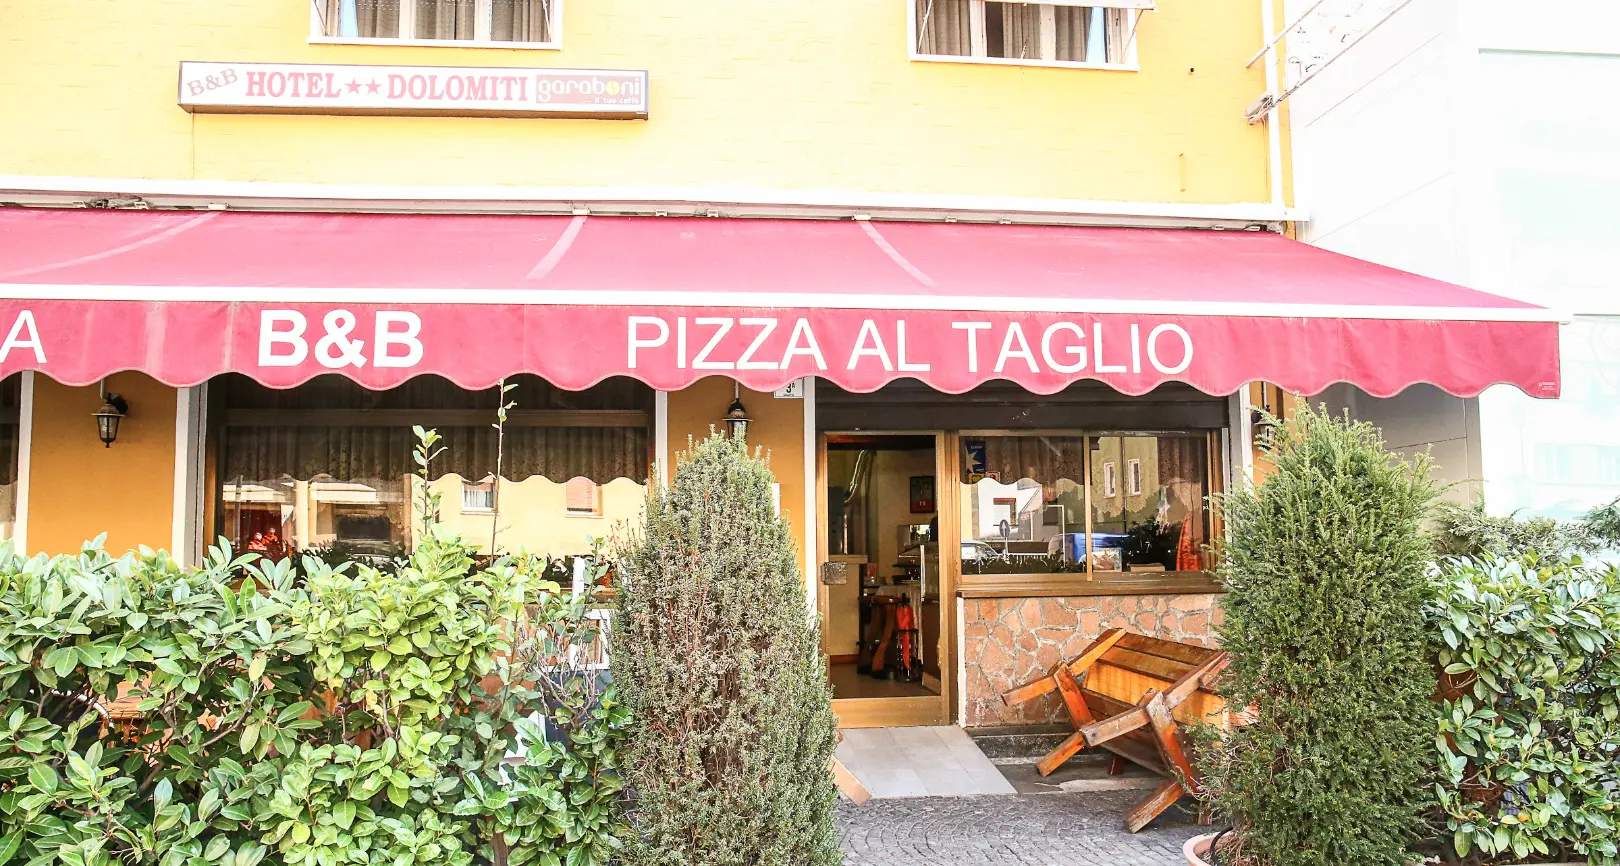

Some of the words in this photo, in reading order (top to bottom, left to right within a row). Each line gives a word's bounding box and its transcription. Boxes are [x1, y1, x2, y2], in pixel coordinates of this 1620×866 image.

[187, 68, 238, 97] B&B
[245, 71, 342, 98] HOTEL
[386, 73, 529, 101] DOLOMITI
[537, 76, 641, 102] garaboni
[603, 96, 617, 104] tuo
[0, 309, 48, 363] A
[257, 308, 424, 369] B&B
[627, 315, 828, 371] PIZZA
[846, 319, 931, 372] AL
[951, 321, 1194, 375] TAGLIO
